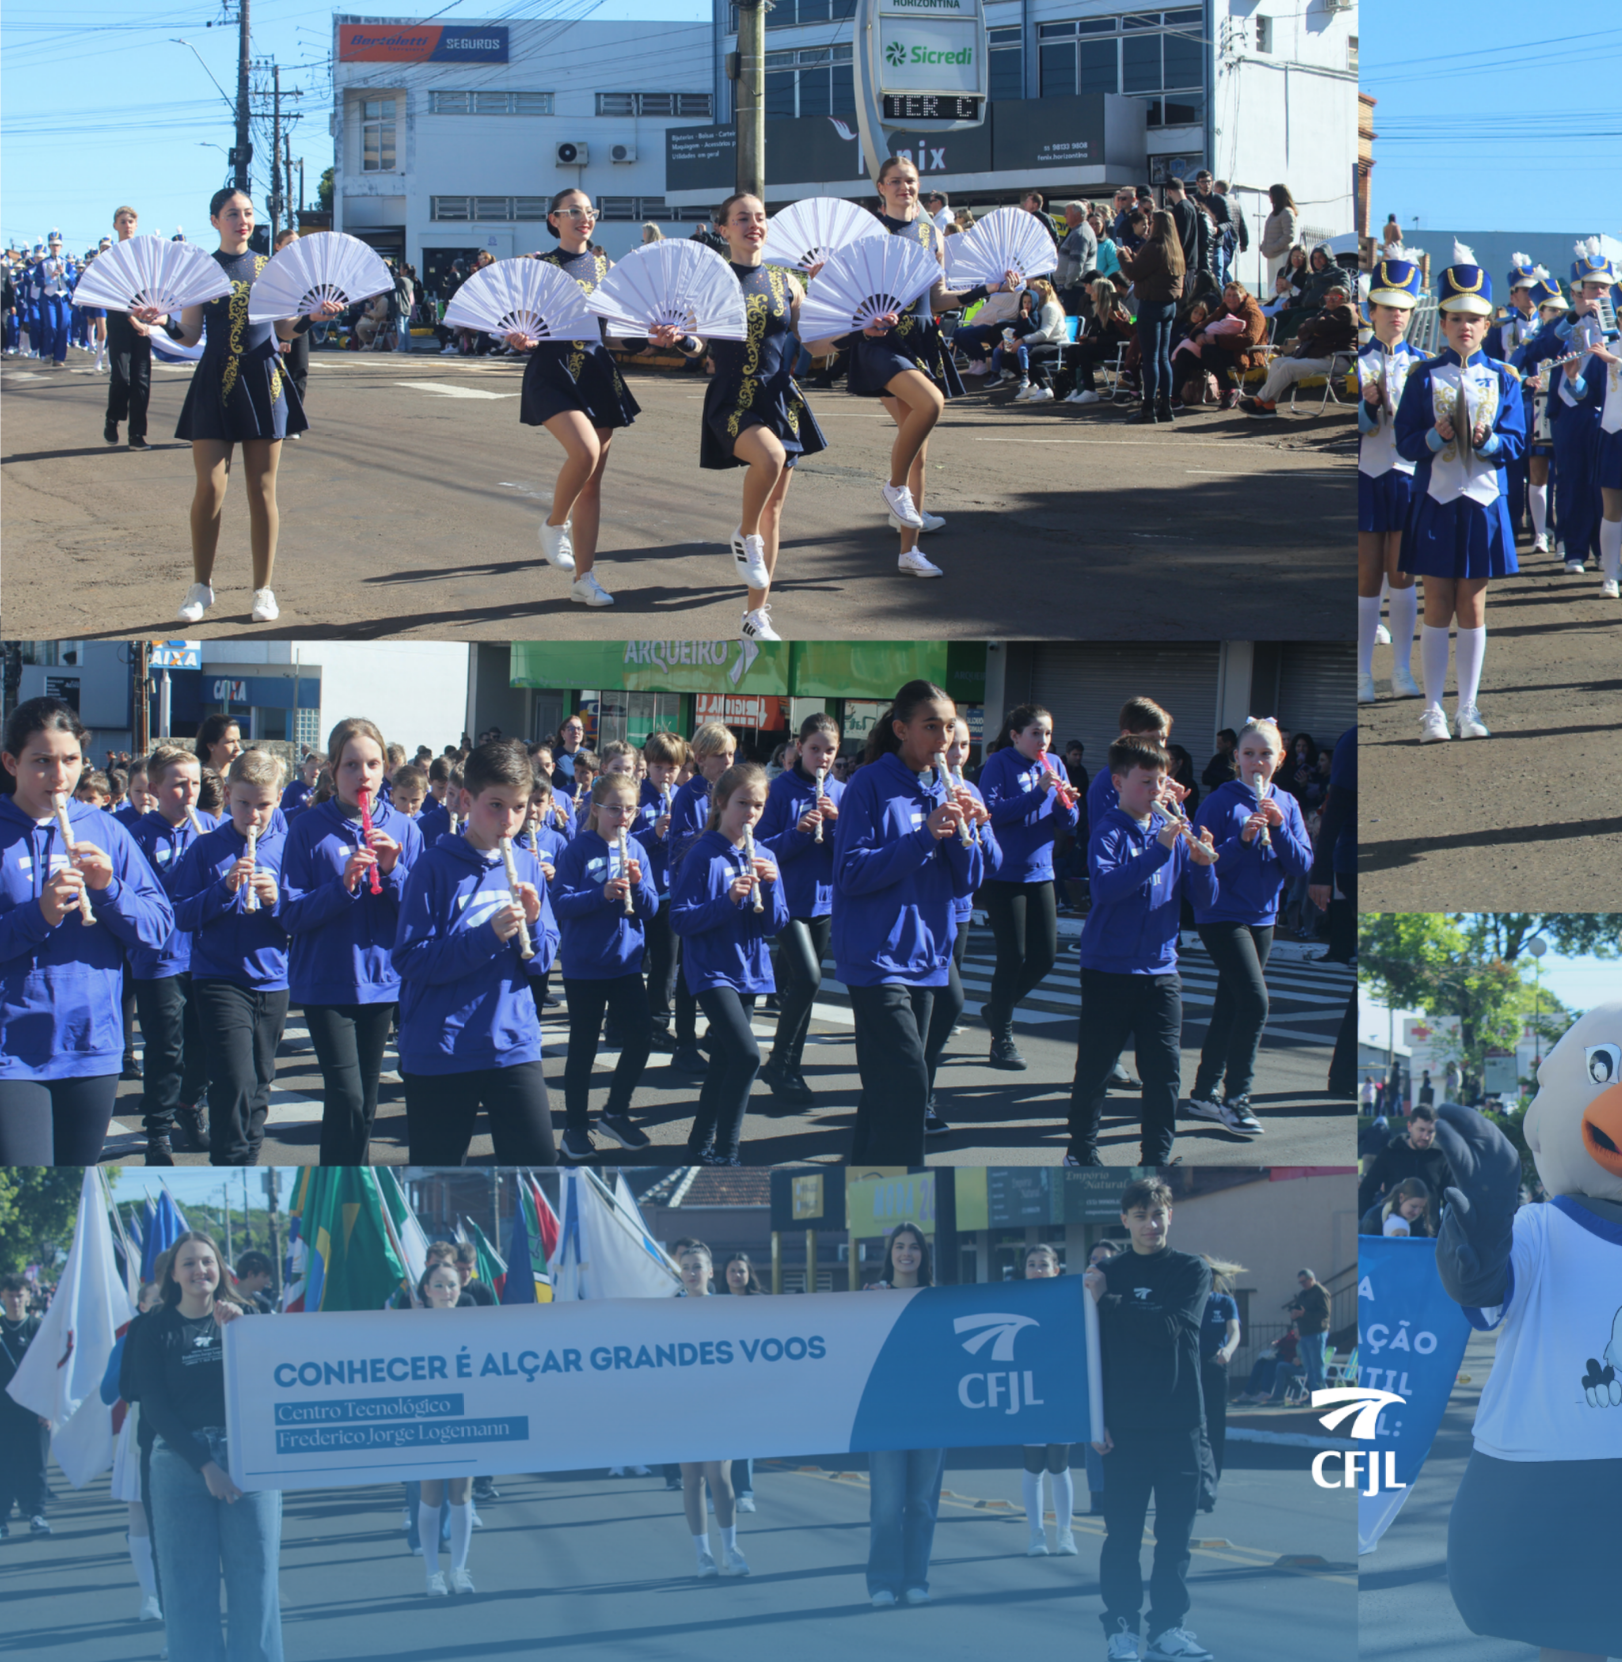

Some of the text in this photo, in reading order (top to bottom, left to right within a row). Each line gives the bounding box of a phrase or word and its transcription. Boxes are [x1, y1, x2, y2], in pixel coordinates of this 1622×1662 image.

[893, 0, 960, 9] HORIZONTINA
[446, 38, 500, 50] SEGUROS
[911, 46, 972, 65] Sicredi
[150, 650, 198, 667] AIXA
[624, 640, 728, 674] ARQUEIRO
[1065, 1171, 1109, 1183] Empório
[1084, 1177, 1129, 1189] Natural
[274, 1335, 826, 1388] CONHECER É ALÇAR GRANDES VOOS
[958, 1371, 1044, 1415] CFJL
[278, 1397, 450, 1421] Centro Tecnológico
[279, 1422, 510, 1448] Frederico Jorge Logemann
